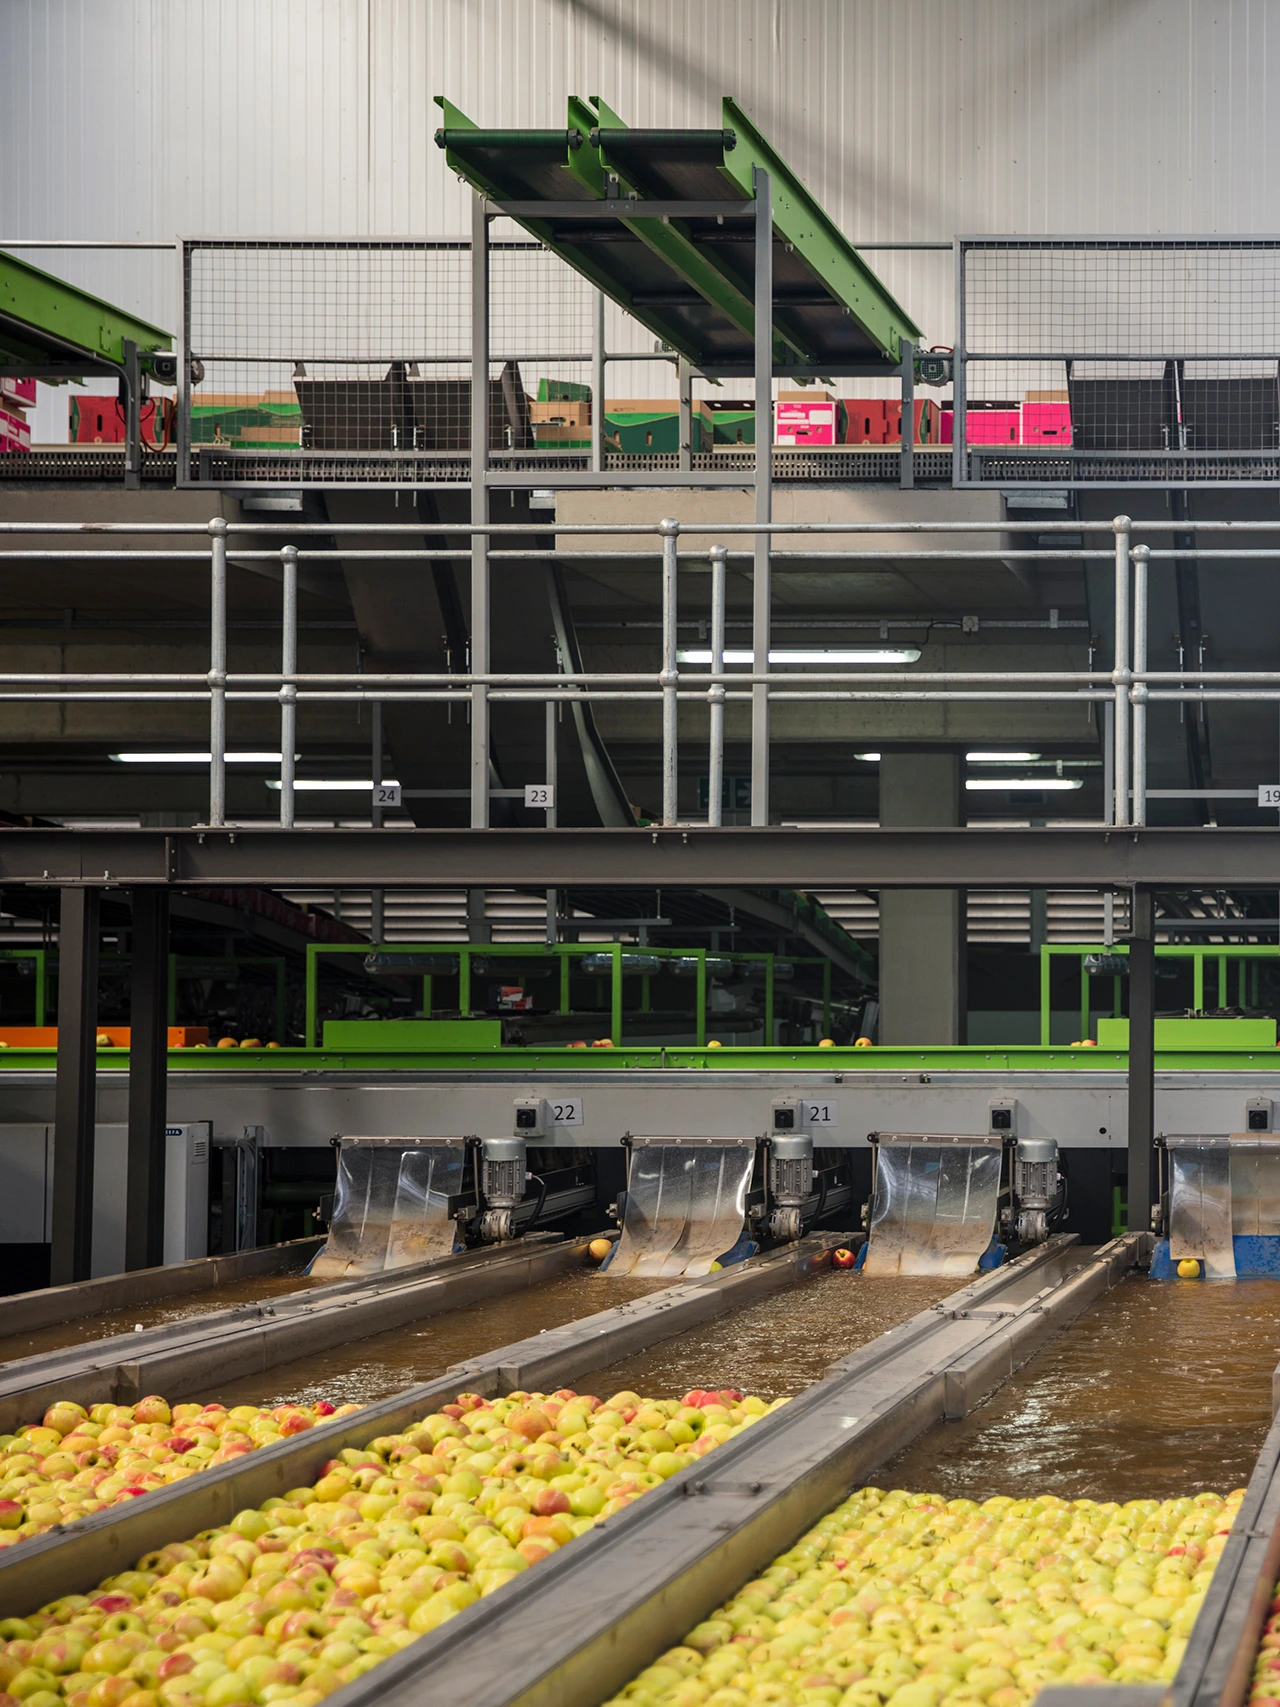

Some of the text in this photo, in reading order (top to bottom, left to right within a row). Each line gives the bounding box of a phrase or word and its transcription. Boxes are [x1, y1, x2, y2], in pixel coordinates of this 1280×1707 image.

[378, 789, 396, 802] 24
[530, 789, 548, 803] 23
[554, 1104, 576, 1121] 22
[809, 1105, 831, 1122] 21
